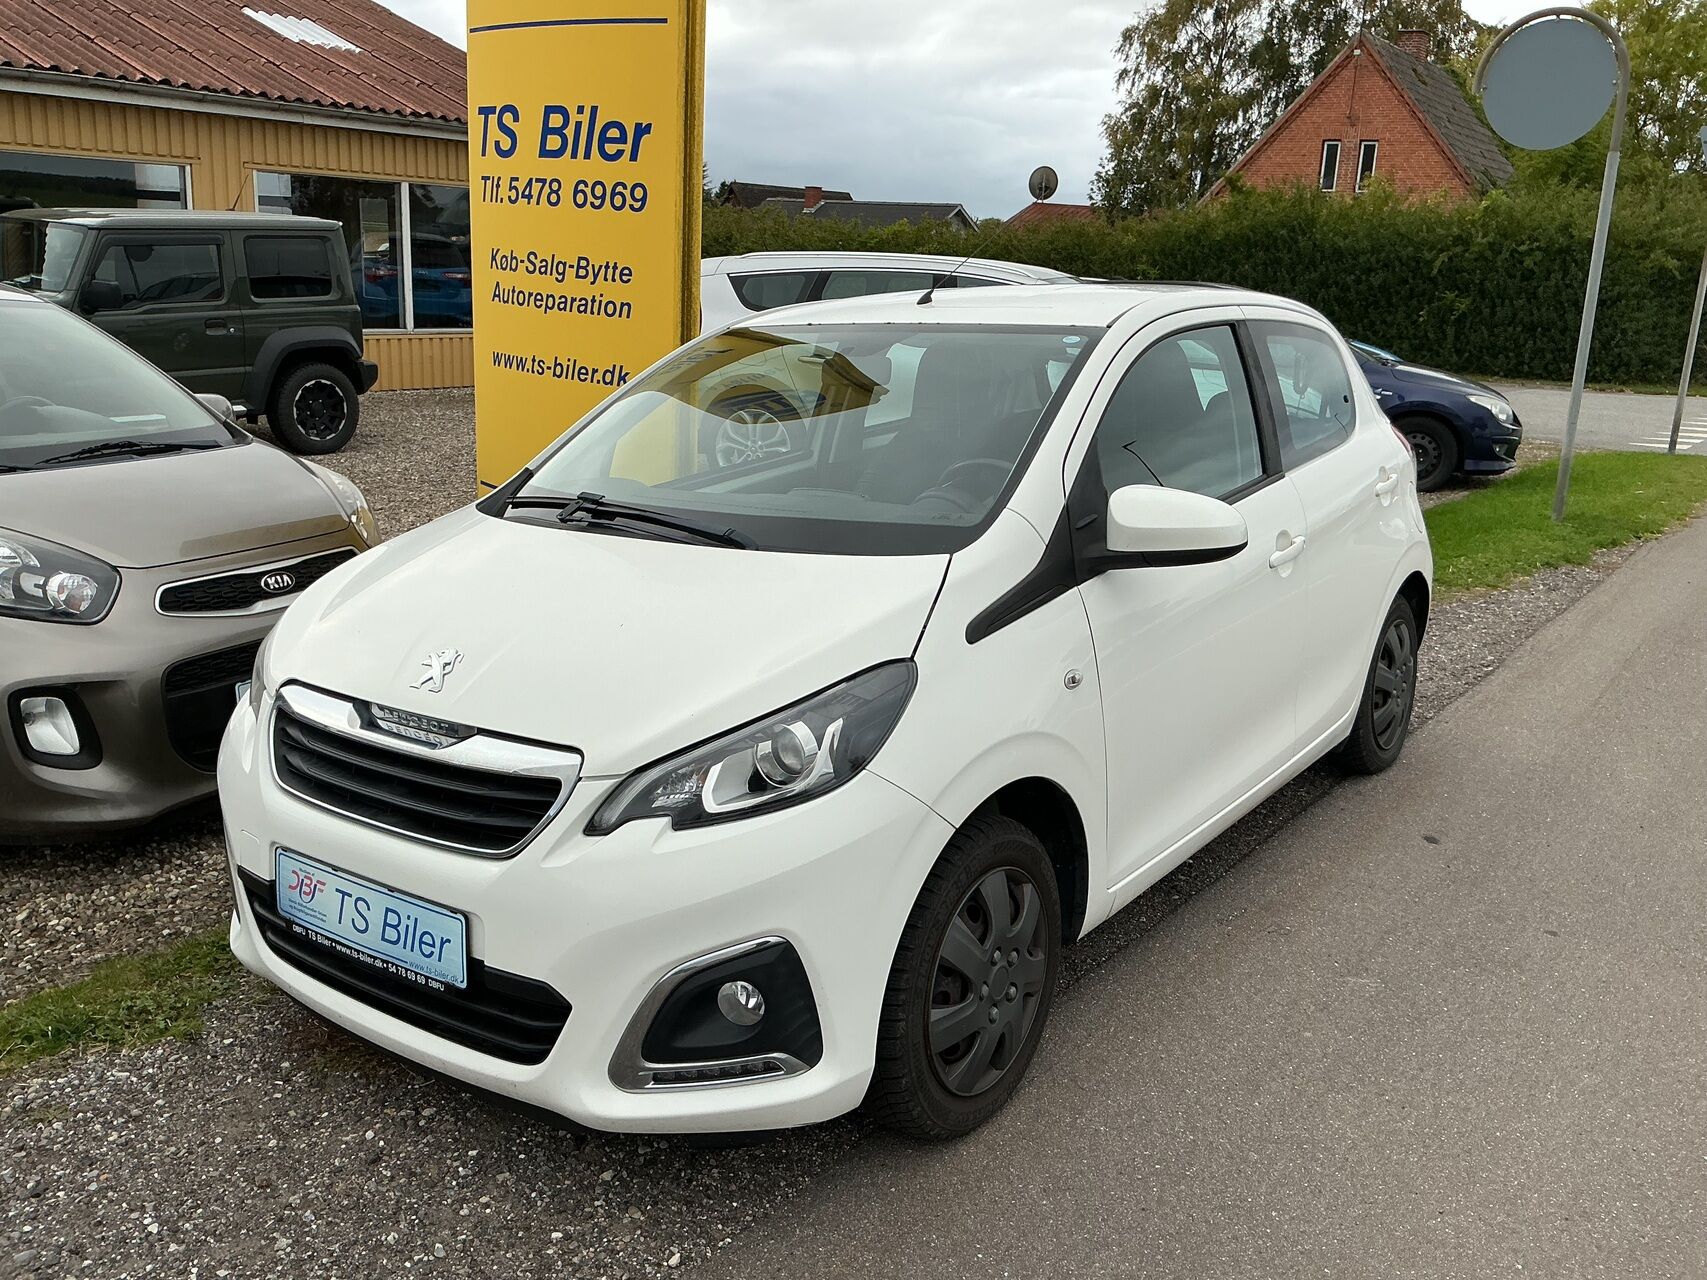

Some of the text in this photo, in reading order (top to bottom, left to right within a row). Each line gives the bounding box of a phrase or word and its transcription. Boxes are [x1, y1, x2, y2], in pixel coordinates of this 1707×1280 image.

[477, 103, 653, 163] TS Biler
[572, 180, 648, 213] 6969
[489, 247, 633, 286] Køb-Salg-Bytte
[491, 281, 633, 319] Autoreparation
[492, 350, 631, 387] www.ts-biler.dk
[266, 574, 292, 590] KIA
[335, 887, 452, 963] TS Biler
[307, 930, 317, 941] TS
[317, 934, 332, 947] Biler
[335, 943, 384, 969] www.ts-biler.dk
[388, 963, 397, 974] 54
[397, 967, 406, 978] 78
[428, 979, 445, 992] DBFU
[408, 960, 460, 984] www.ts-biler.dk
